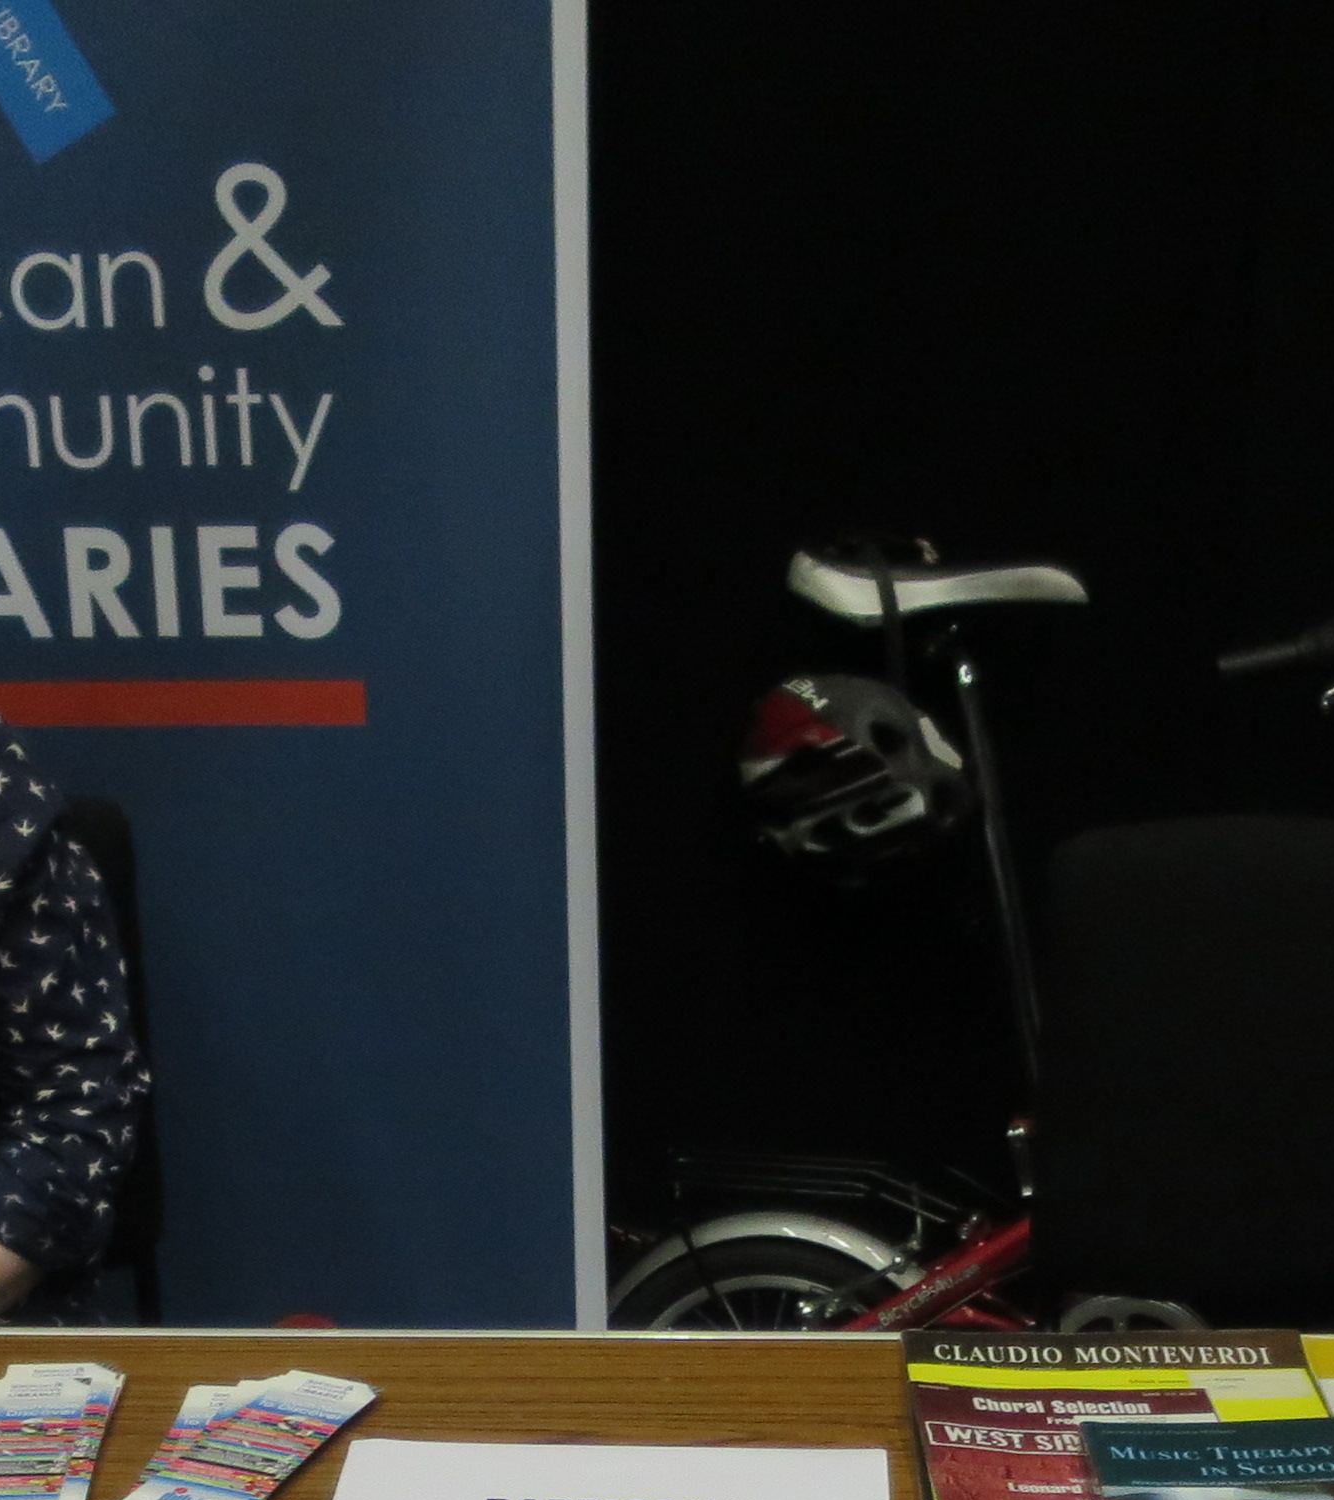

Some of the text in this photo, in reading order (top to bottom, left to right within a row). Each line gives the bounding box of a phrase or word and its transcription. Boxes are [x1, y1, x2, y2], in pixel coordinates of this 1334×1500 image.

[204, 163, 344, 331] &
[933, 1343, 1272, 1367] CLAUDIO MONTEVERDI
[971, 1396, 1152, 1416] Choral Selection
[943, 1425, 1024, 1449] WEST
[1109, 1445, 1330, 1460] MUSIC THERAPY
[1200, 1466, 1227, 1475] IN
[1007, 1482, 1083, 1493] Leonard
